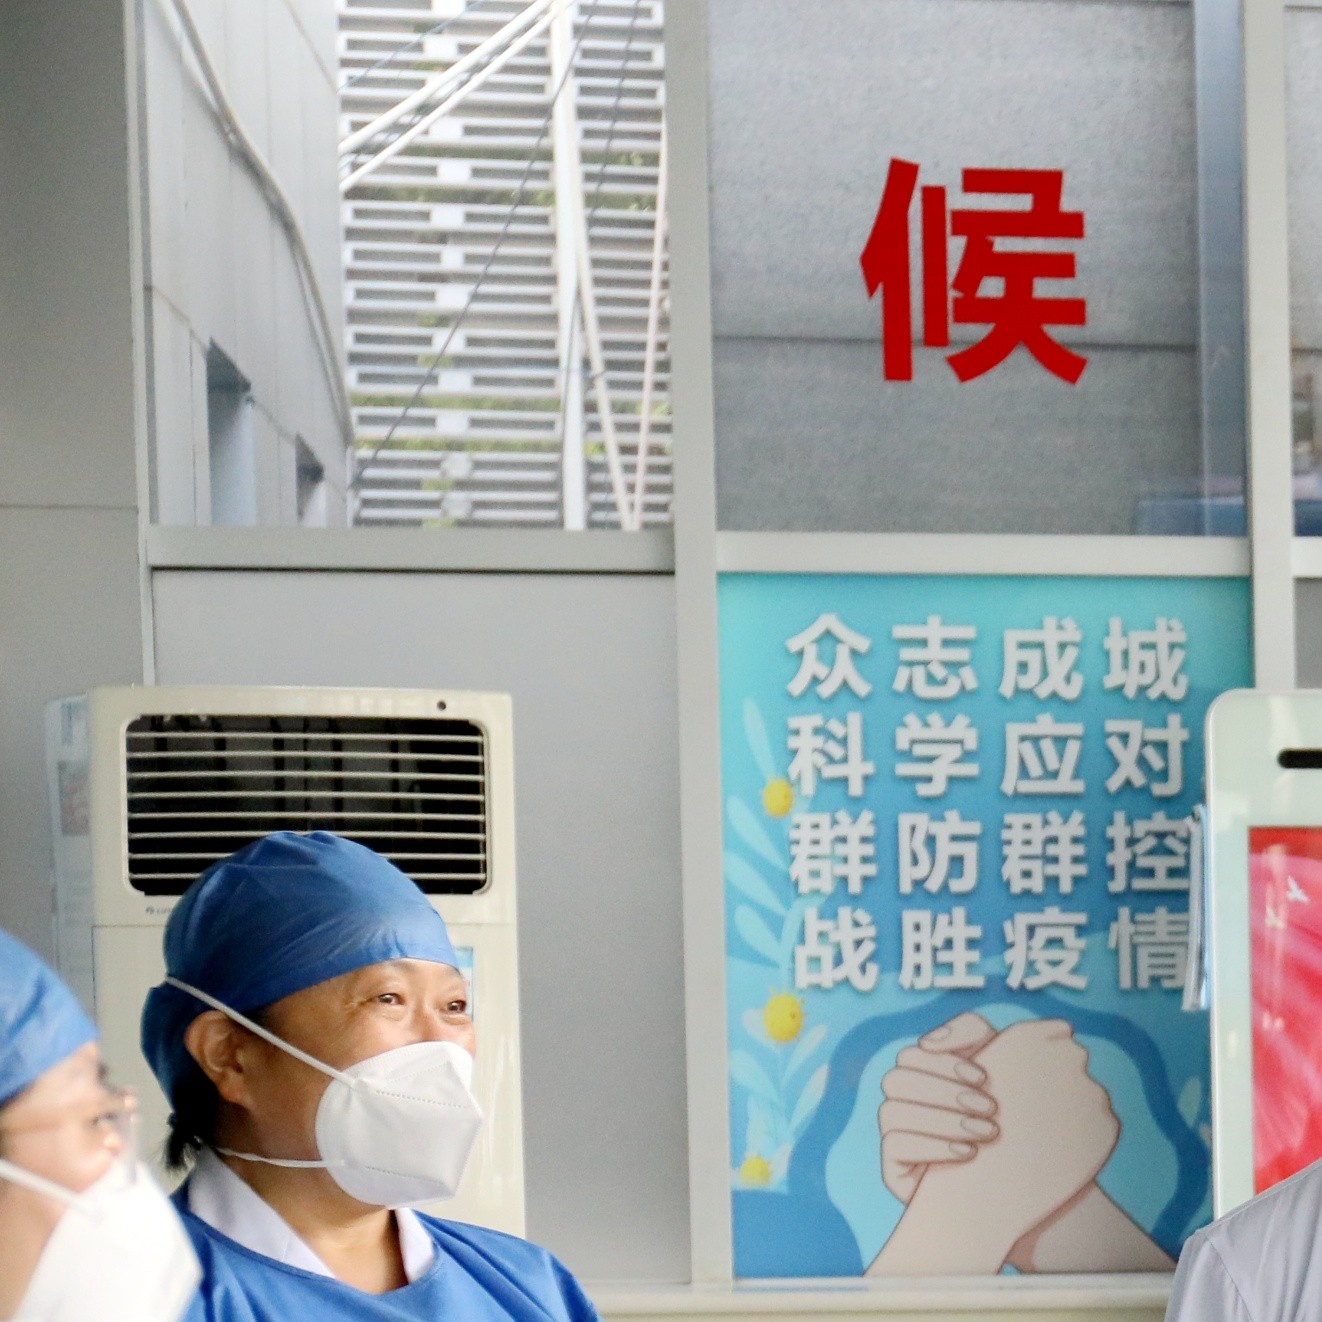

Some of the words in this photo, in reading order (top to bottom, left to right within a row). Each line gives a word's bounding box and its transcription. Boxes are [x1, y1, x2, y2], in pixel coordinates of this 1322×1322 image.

[784, 612, 1190, 702] 众志成城
[786, 711, 1190, 798] 科学应对
[787, 811, 1193, 896] 群防群控
[795, 906, 1192, 993] 战胜疫情
